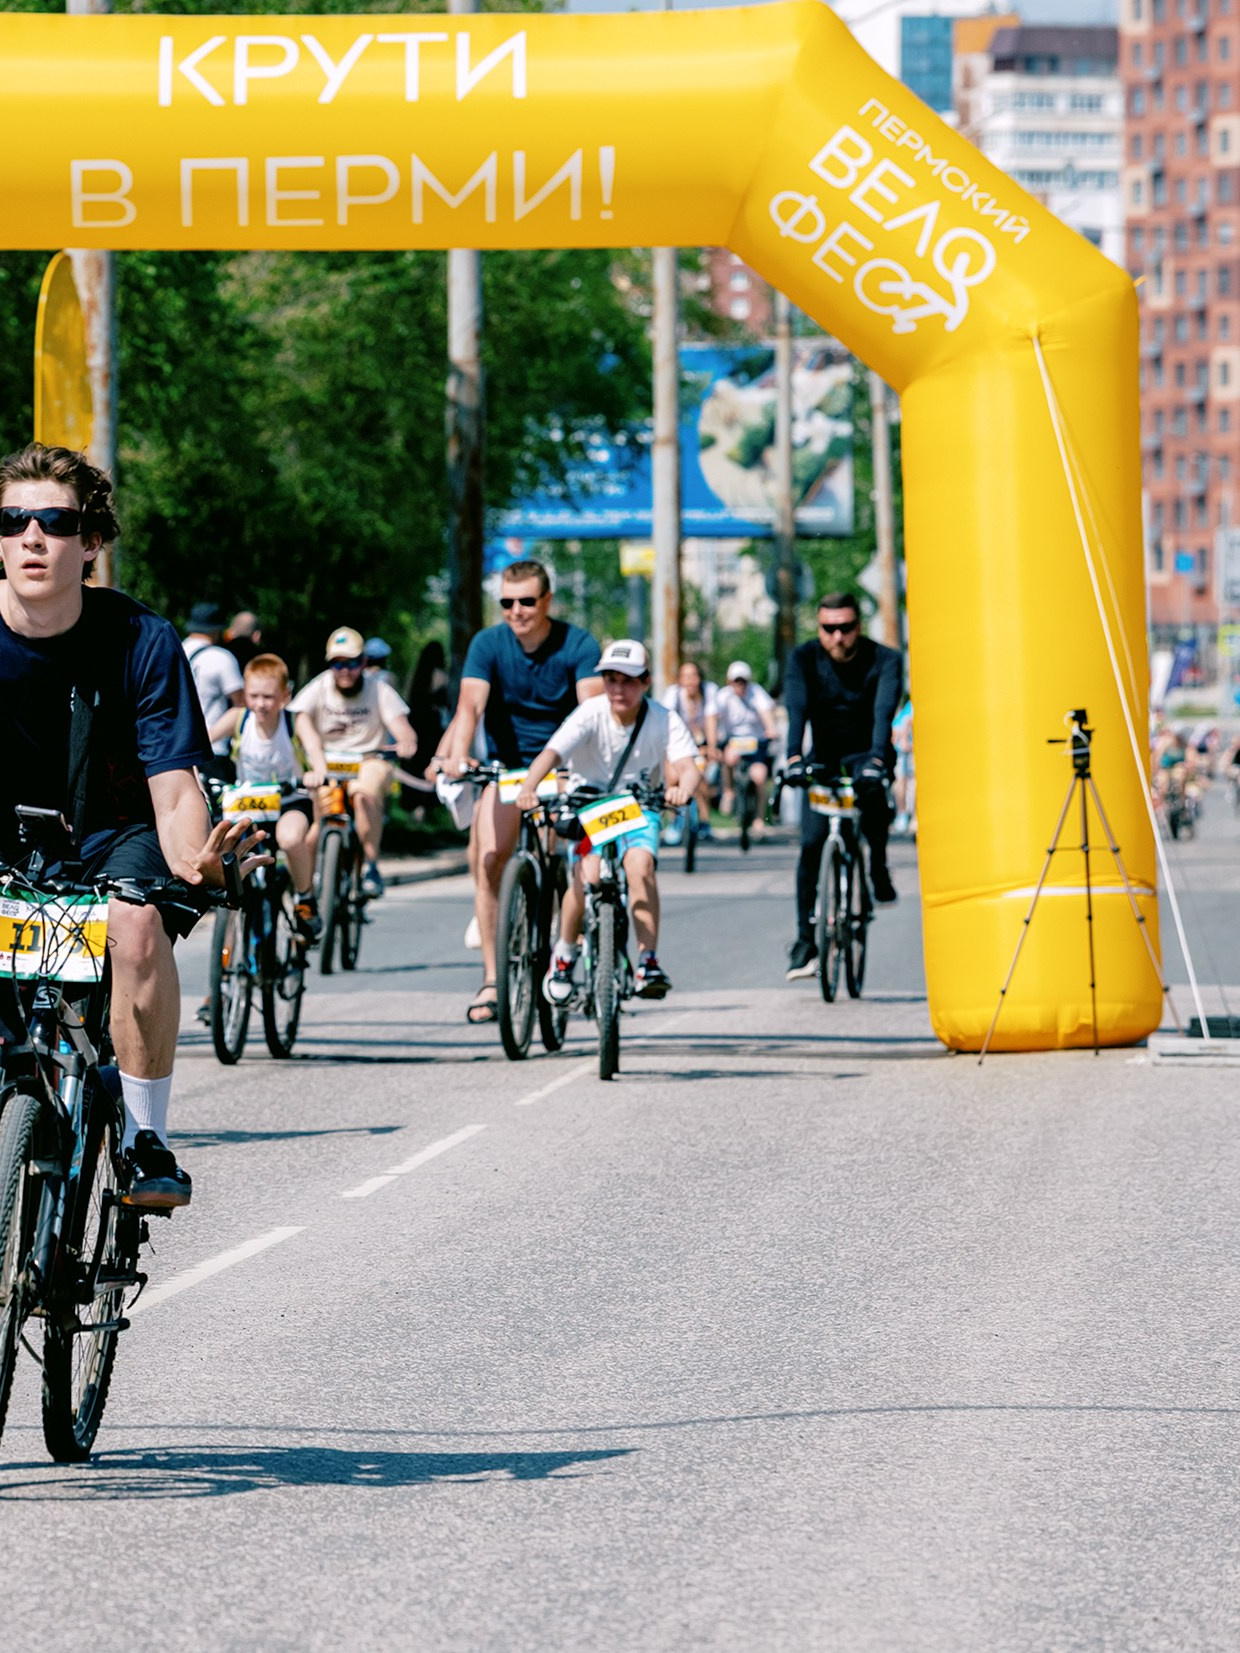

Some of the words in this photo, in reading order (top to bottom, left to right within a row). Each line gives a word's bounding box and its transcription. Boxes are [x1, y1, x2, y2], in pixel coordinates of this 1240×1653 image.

[158, 30, 528, 107] КРУТИ
[70, 158, 138, 229] В
[179, 145, 617, 228] ПЕРМИ!
[858, 97, 1031, 245] ПЕРМСКИЙ
[599, 809, 628, 828] 952
